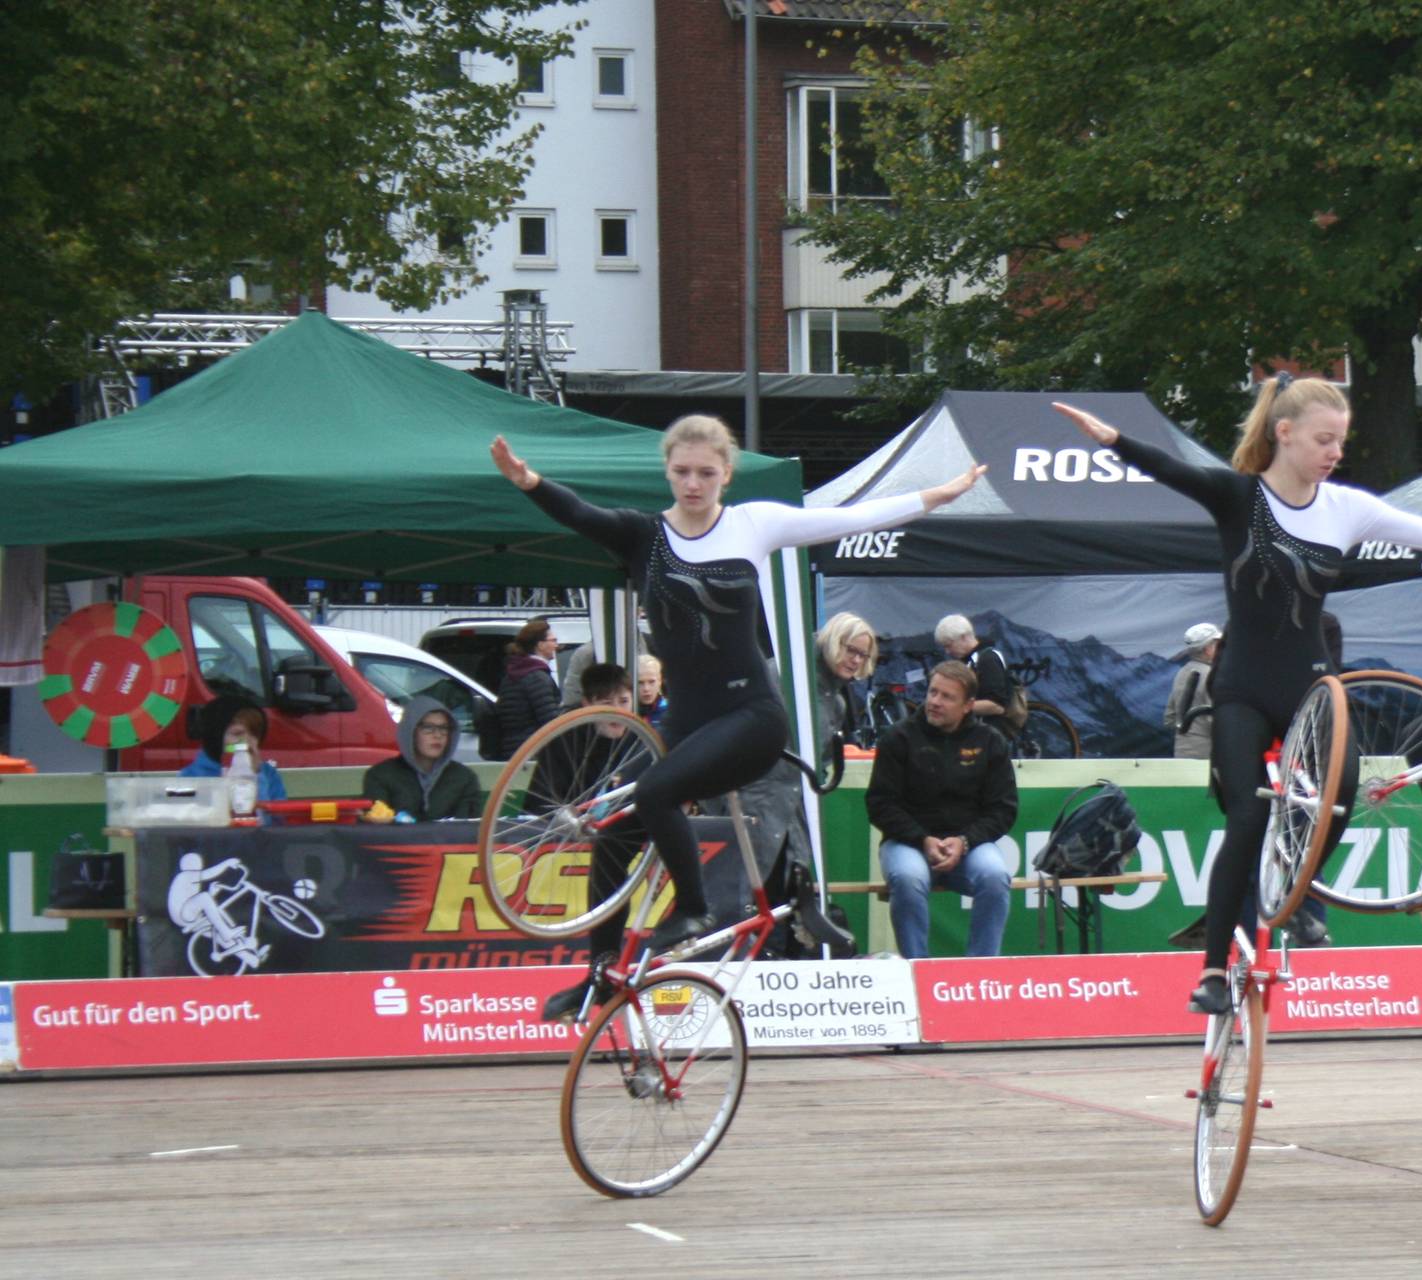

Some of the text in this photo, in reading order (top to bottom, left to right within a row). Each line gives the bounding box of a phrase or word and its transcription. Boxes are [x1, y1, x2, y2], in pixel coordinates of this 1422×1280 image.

[835, 530, 904, 558] ROSE
[755, 971, 873, 991] 100 Jahre
[932, 977, 1138, 1001] Gut für den Sport.
[33, 1005, 80, 1027] Gut
[84, 1003, 122, 1025] für
[127, 1001, 177, 1023] den
[183, 1000, 261, 1026] Sport.
[419, 994, 537, 1018] Sparkasse
[1287, 996, 1419, 1018] Münsterland
[753, 1023, 887, 1039] Münster von 1895
